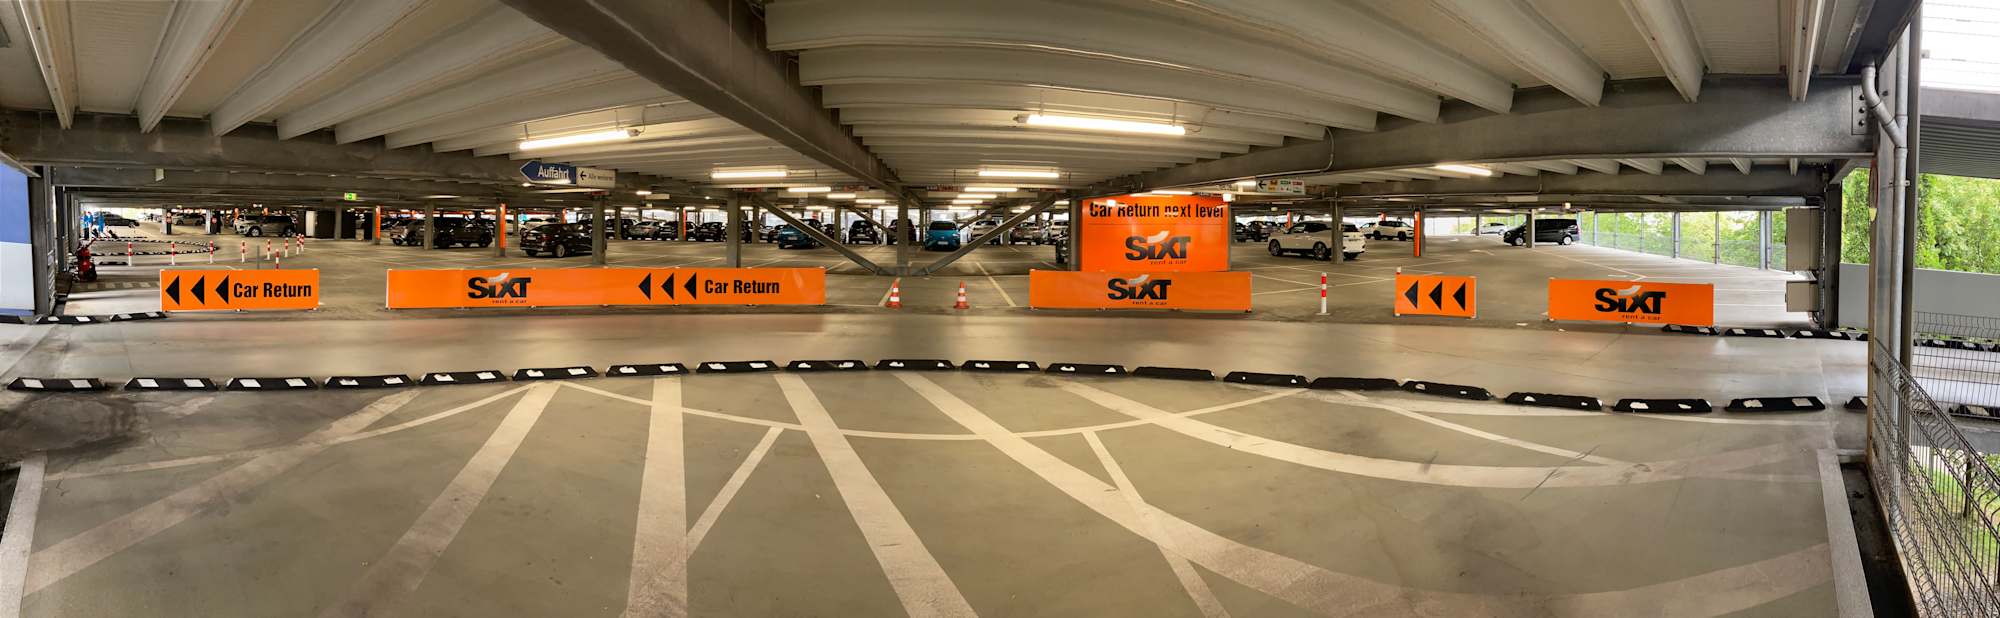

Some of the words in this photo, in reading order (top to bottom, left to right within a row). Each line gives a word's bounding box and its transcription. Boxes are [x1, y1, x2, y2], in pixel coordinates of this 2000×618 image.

[537, 165, 569, 179] Auffahrt
[1090, 202, 1113, 217] Car
[1117, 203, 1159, 217] Return
[1164, 204, 1191, 218] next
[1195, 203, 1224, 218] level
[233, 282, 258, 298] Car
[263, 282, 312, 298] Return
[705, 279, 728, 294] Car
[733, 279, 780, 294] Return
